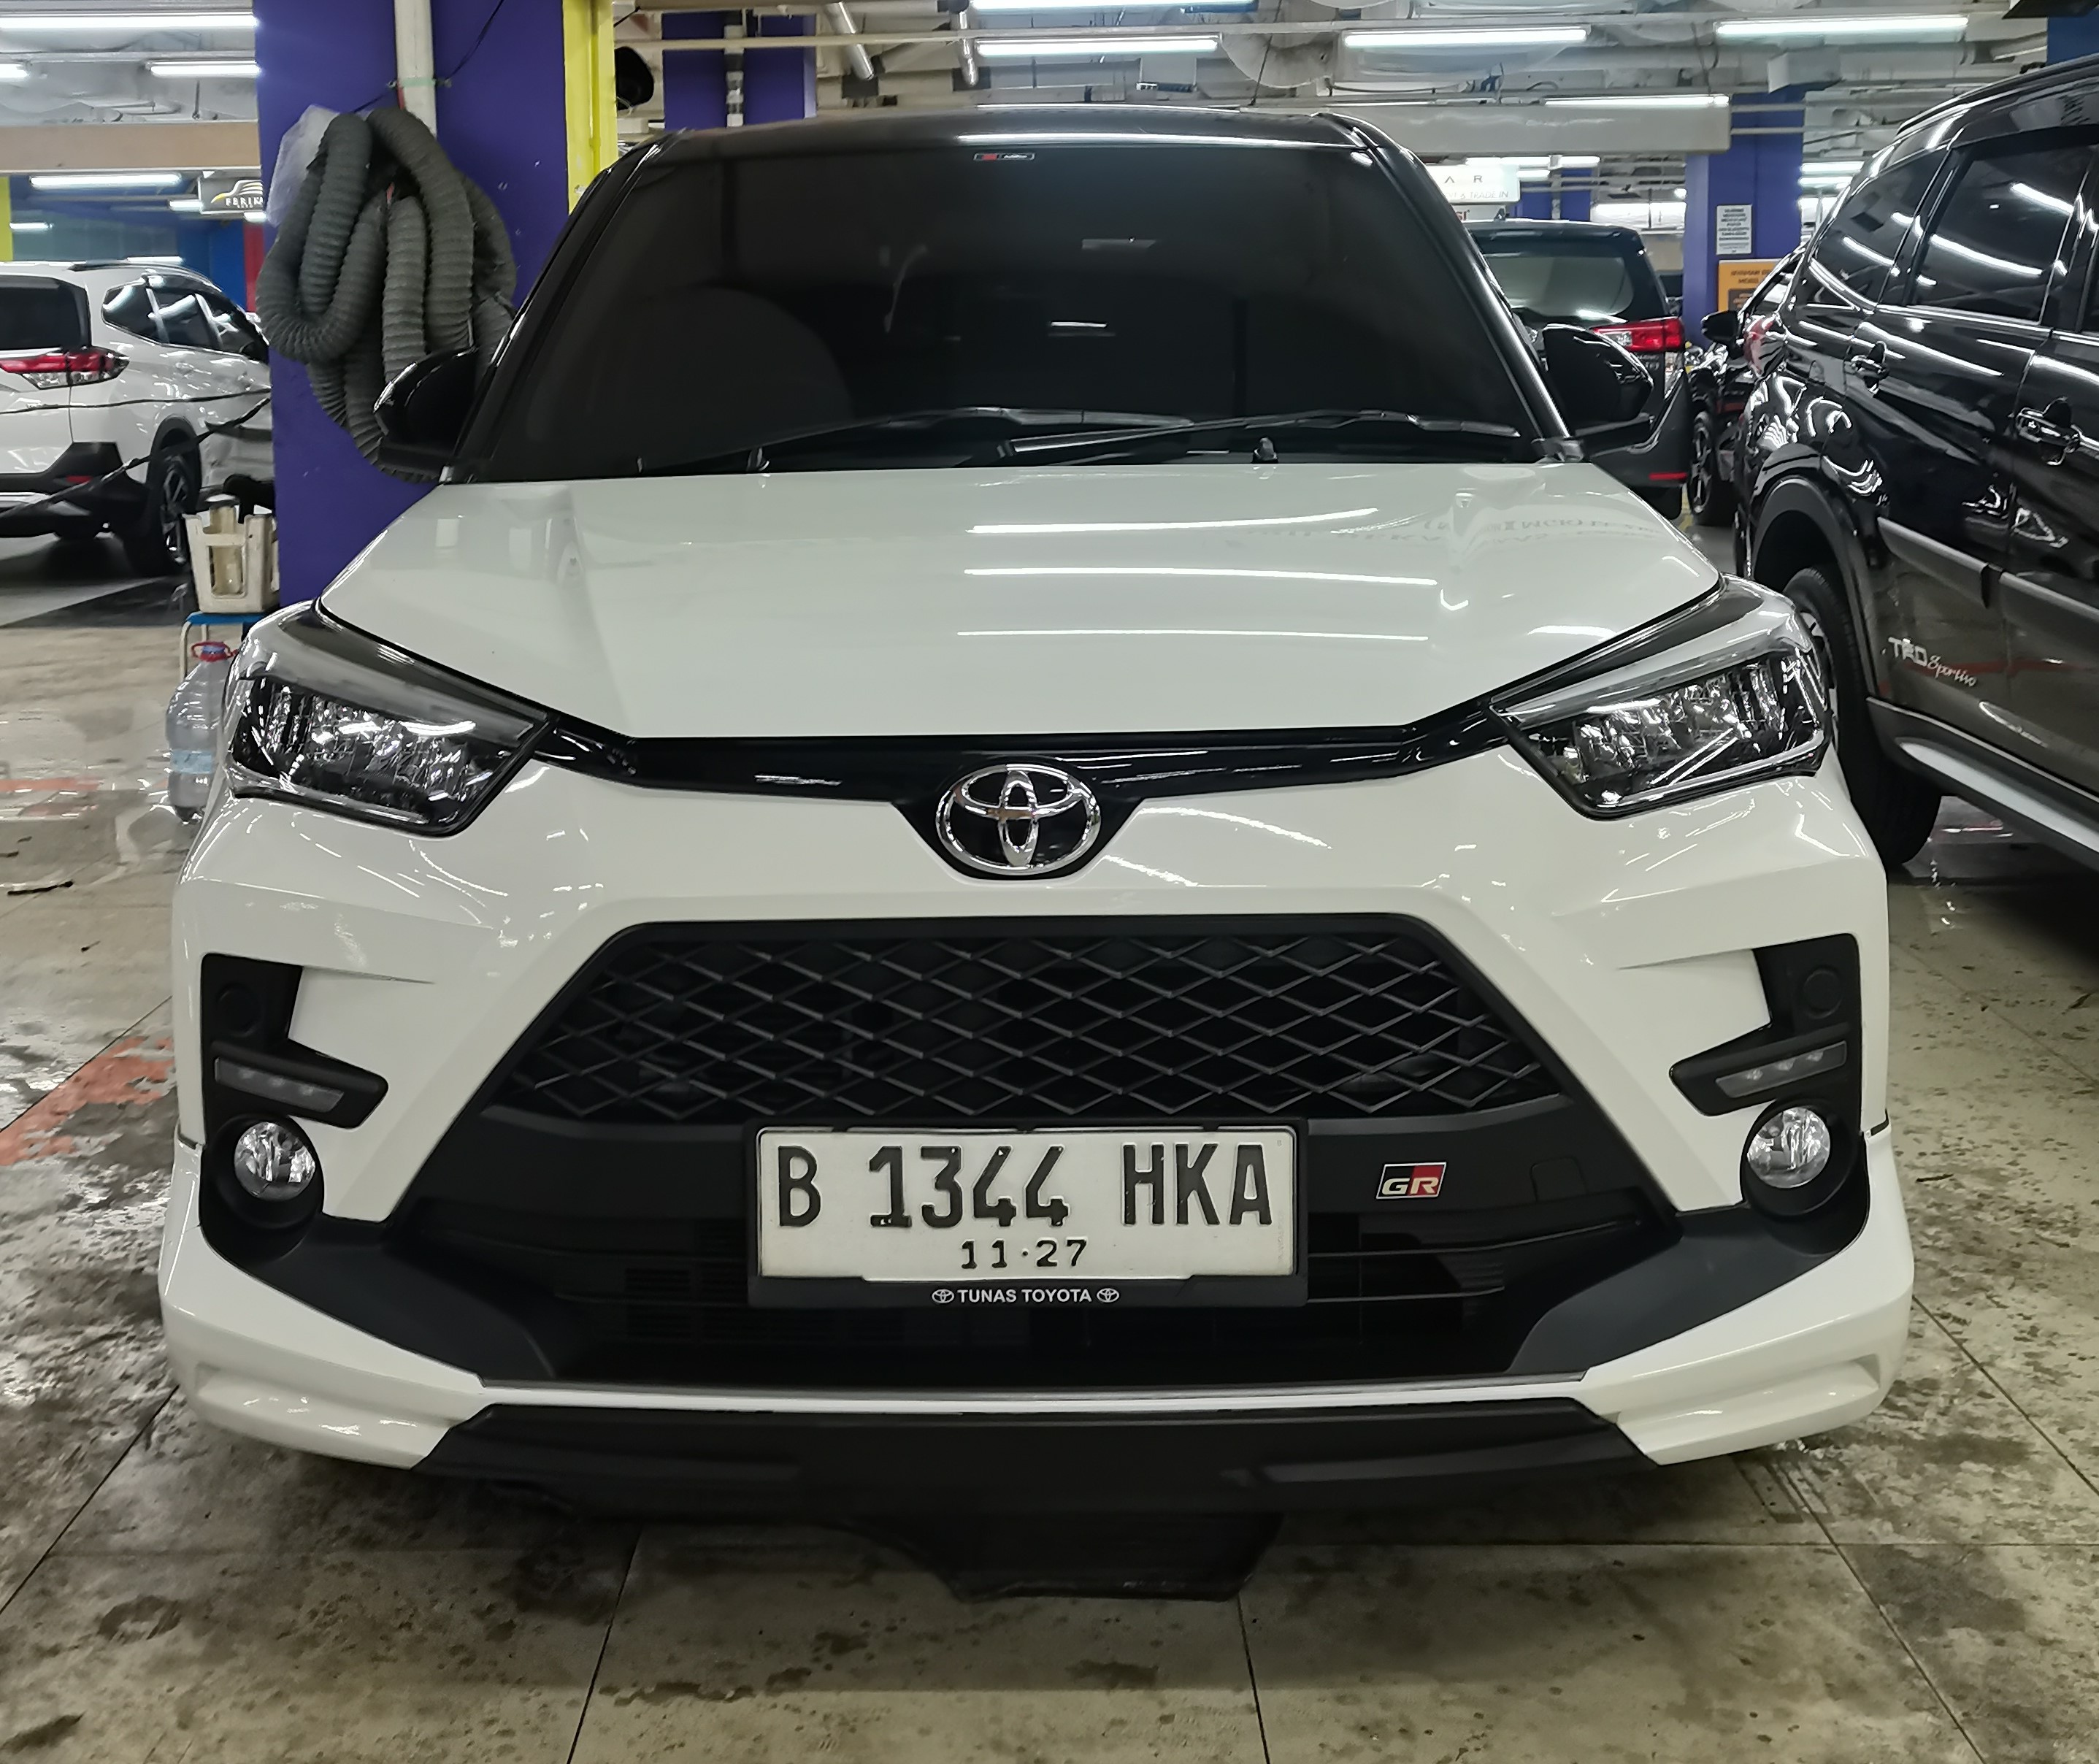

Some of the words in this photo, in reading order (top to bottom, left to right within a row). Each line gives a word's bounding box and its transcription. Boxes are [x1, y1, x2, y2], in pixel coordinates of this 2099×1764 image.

[1470, 191, 1494, 199] TRADE
[1499, 190, 1509, 198] IN
[1888, 636, 1927, 667] TRD
[1927, 655, 1977, 687] Sportivo
[778, 1145, 821, 1227] B
[868, 1145, 1070, 1227] 1344
[1122, 1143, 1273, 1226] HKA
[1381, 1176, 1440, 1195] GR
[956, 1289, 1018, 1303] TUNAS
[1021, 1288, 1093, 1303] TOYOTA
